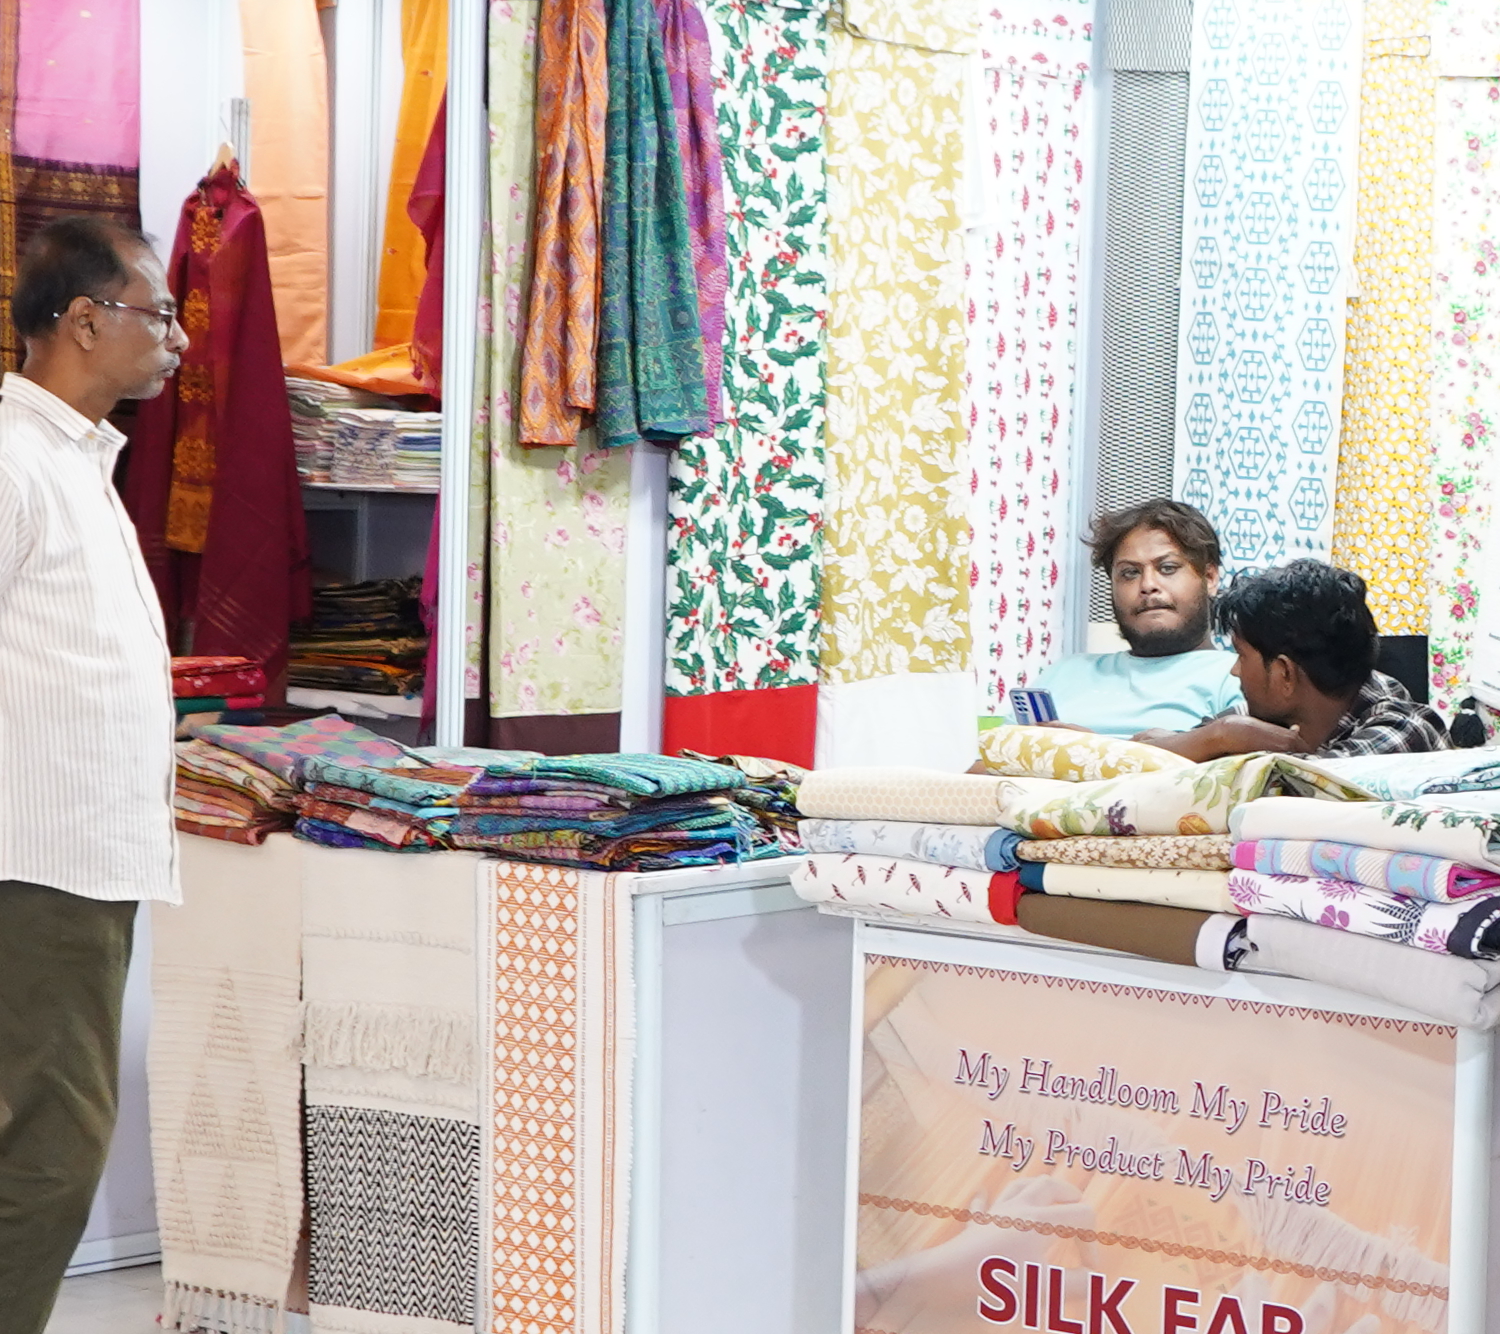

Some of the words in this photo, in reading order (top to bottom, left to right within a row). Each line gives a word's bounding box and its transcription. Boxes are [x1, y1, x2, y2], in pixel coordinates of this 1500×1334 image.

[954, 1048, 1010, 1099] My
[1018, 1056, 1180, 1114] Handloom
[1189, 1081, 1249, 1133] My
[1258, 1090, 1348, 1137] Pride
[978, 1119, 1034, 1171] My
[1043, 1127, 1164, 1180] Product
[1173, 1148, 1233, 1202] My
[1243, 1158, 1332, 1206] Pride
